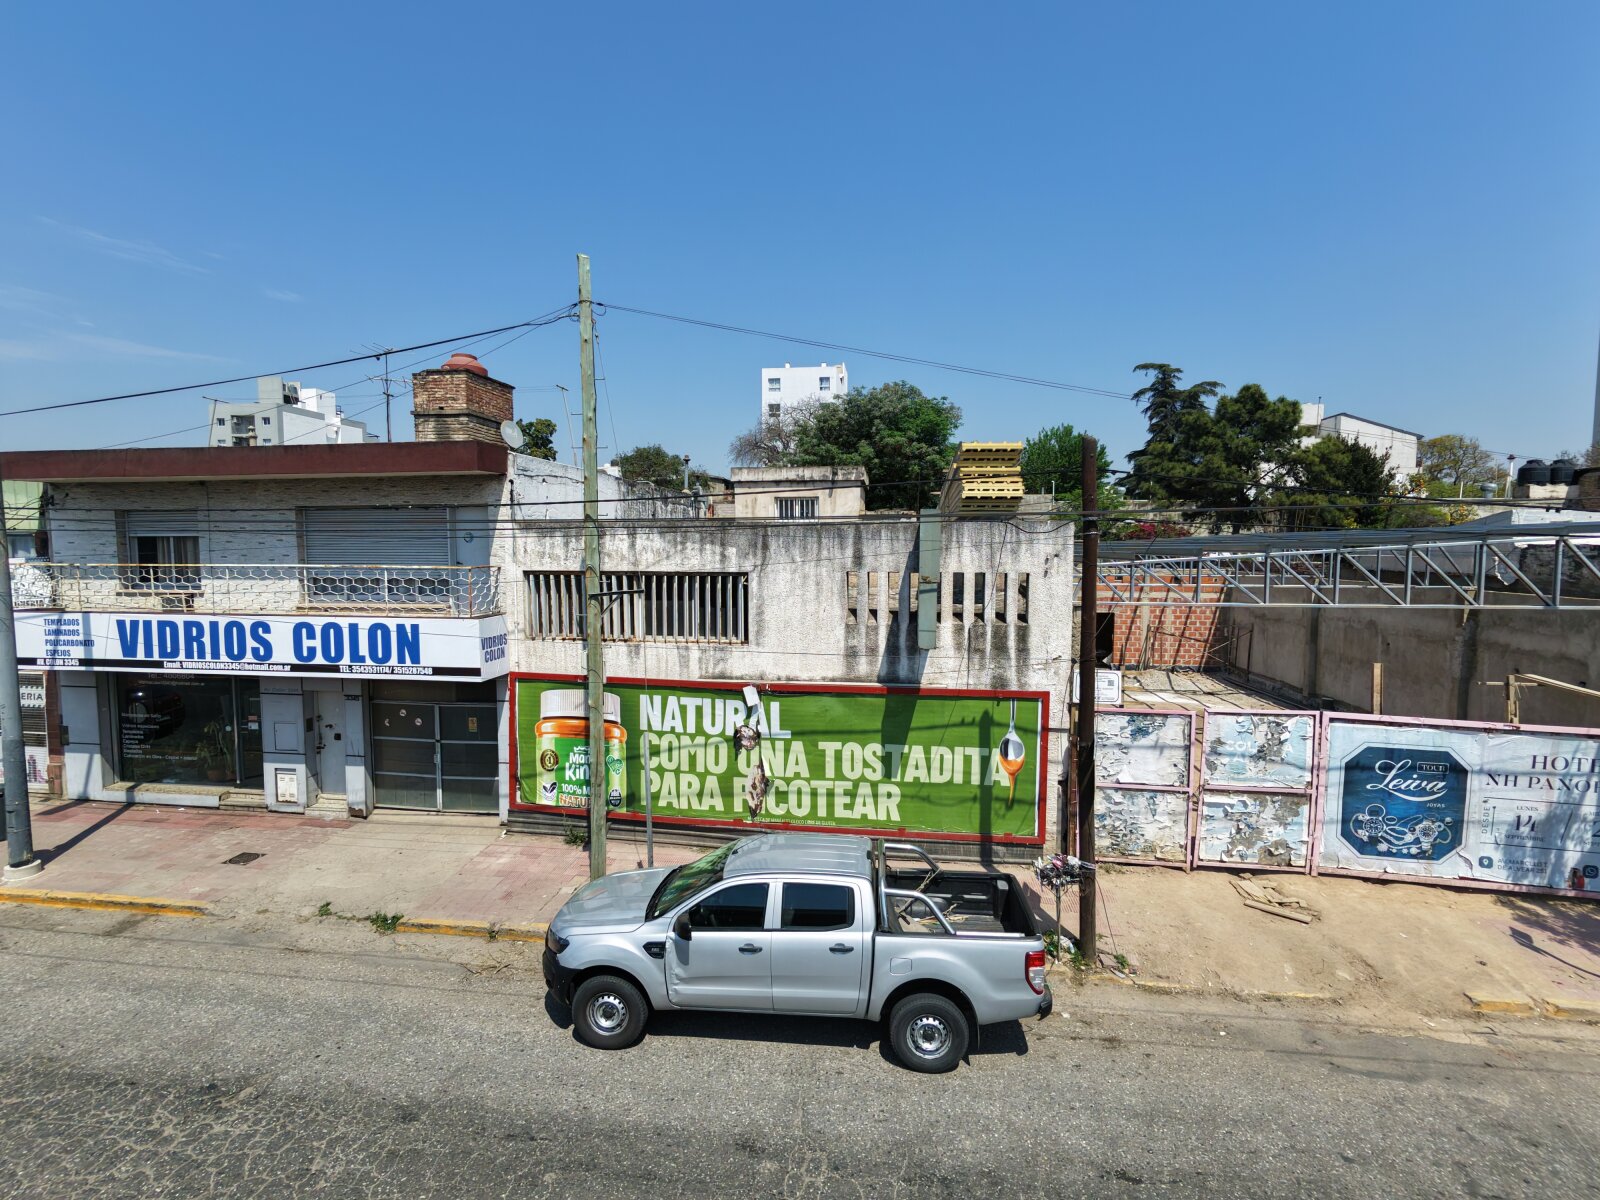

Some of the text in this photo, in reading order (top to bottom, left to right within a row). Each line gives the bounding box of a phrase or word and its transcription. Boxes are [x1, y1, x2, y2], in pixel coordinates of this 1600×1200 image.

[44, 618, 80, 626] TEMPLADOS
[44, 629, 80, 637] LAMINADOS
[45, 639, 95, 647] POLICARBONATO
[116, 619, 421, 664] VIDRIOS COLON
[481, 633, 508, 651] VIDRIOS
[46, 649, 71, 657] ESPEJOS
[484, 646, 506, 663] COLON
[163, 661, 182, 669] Email:
[339, 665, 352, 673] TEL:
[639, 694, 792, 739] NATURAL
[640, 733, 728, 774] COMO
[737, 740, 810, 779] UNA
[818, 741, 1010, 787] TOSTADITA
[1421, 763, 1445, 772] TOUR
[1366, 759, 1448, 802] Leiva
[1486, 773, 1519, 788] NH
[561, 784, 582, 794] 100%
[640, 770, 725, 812] PARA
[1481, 806, 1491, 834] DESDE
[1515, 814, 1537, 833] 14
